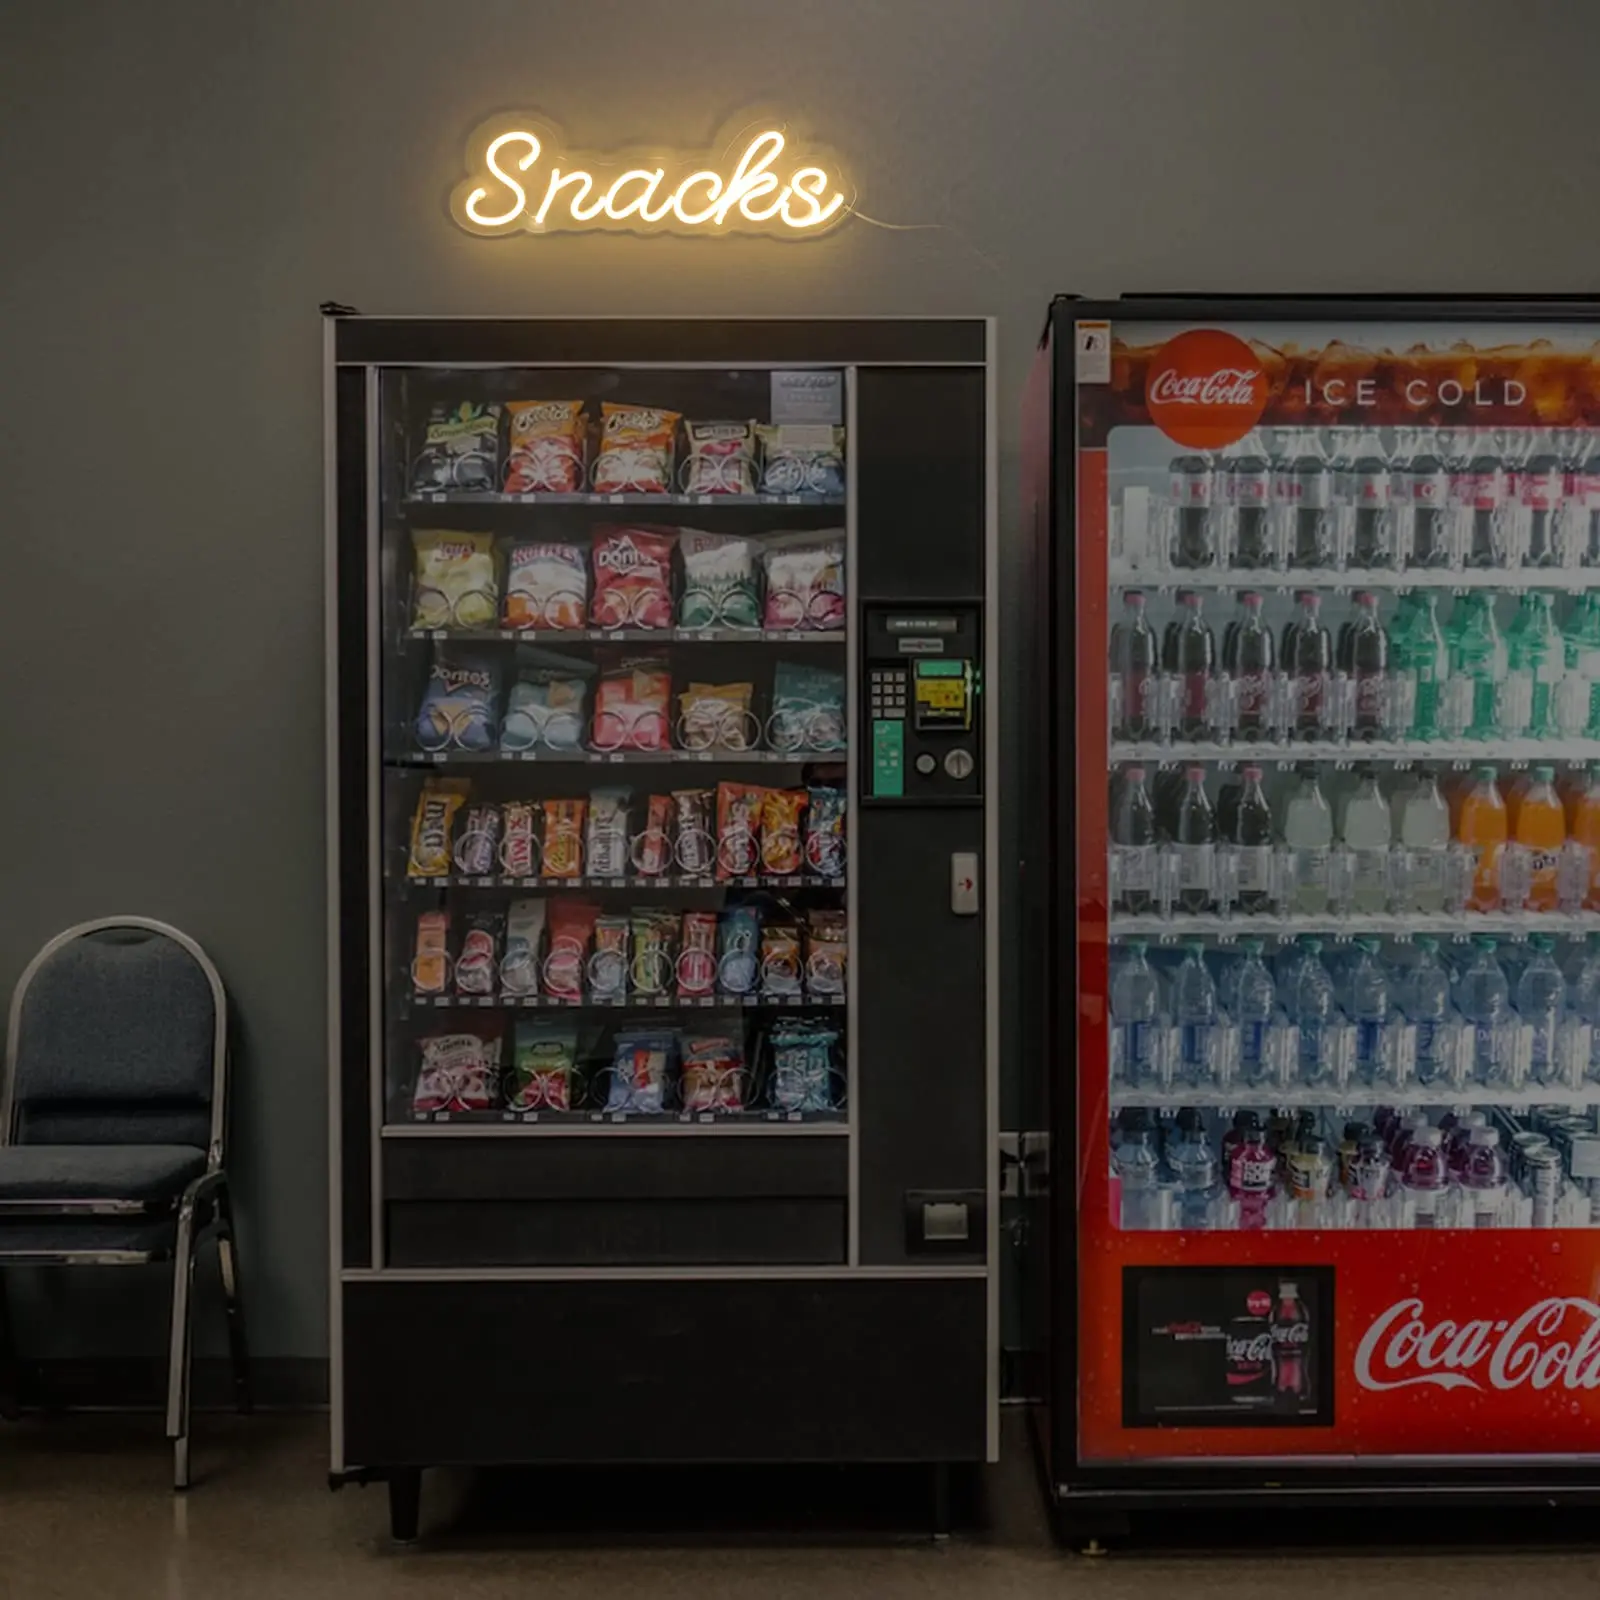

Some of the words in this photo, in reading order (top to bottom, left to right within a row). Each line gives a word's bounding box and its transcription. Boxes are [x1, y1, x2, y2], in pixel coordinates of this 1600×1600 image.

[465, 130, 844, 228] Snacks
[1150, 366, 1260, 406] Coca-Cola
[1304, 379, 1377, 406] ICE
[1405, 379, 1526, 406] COLD
